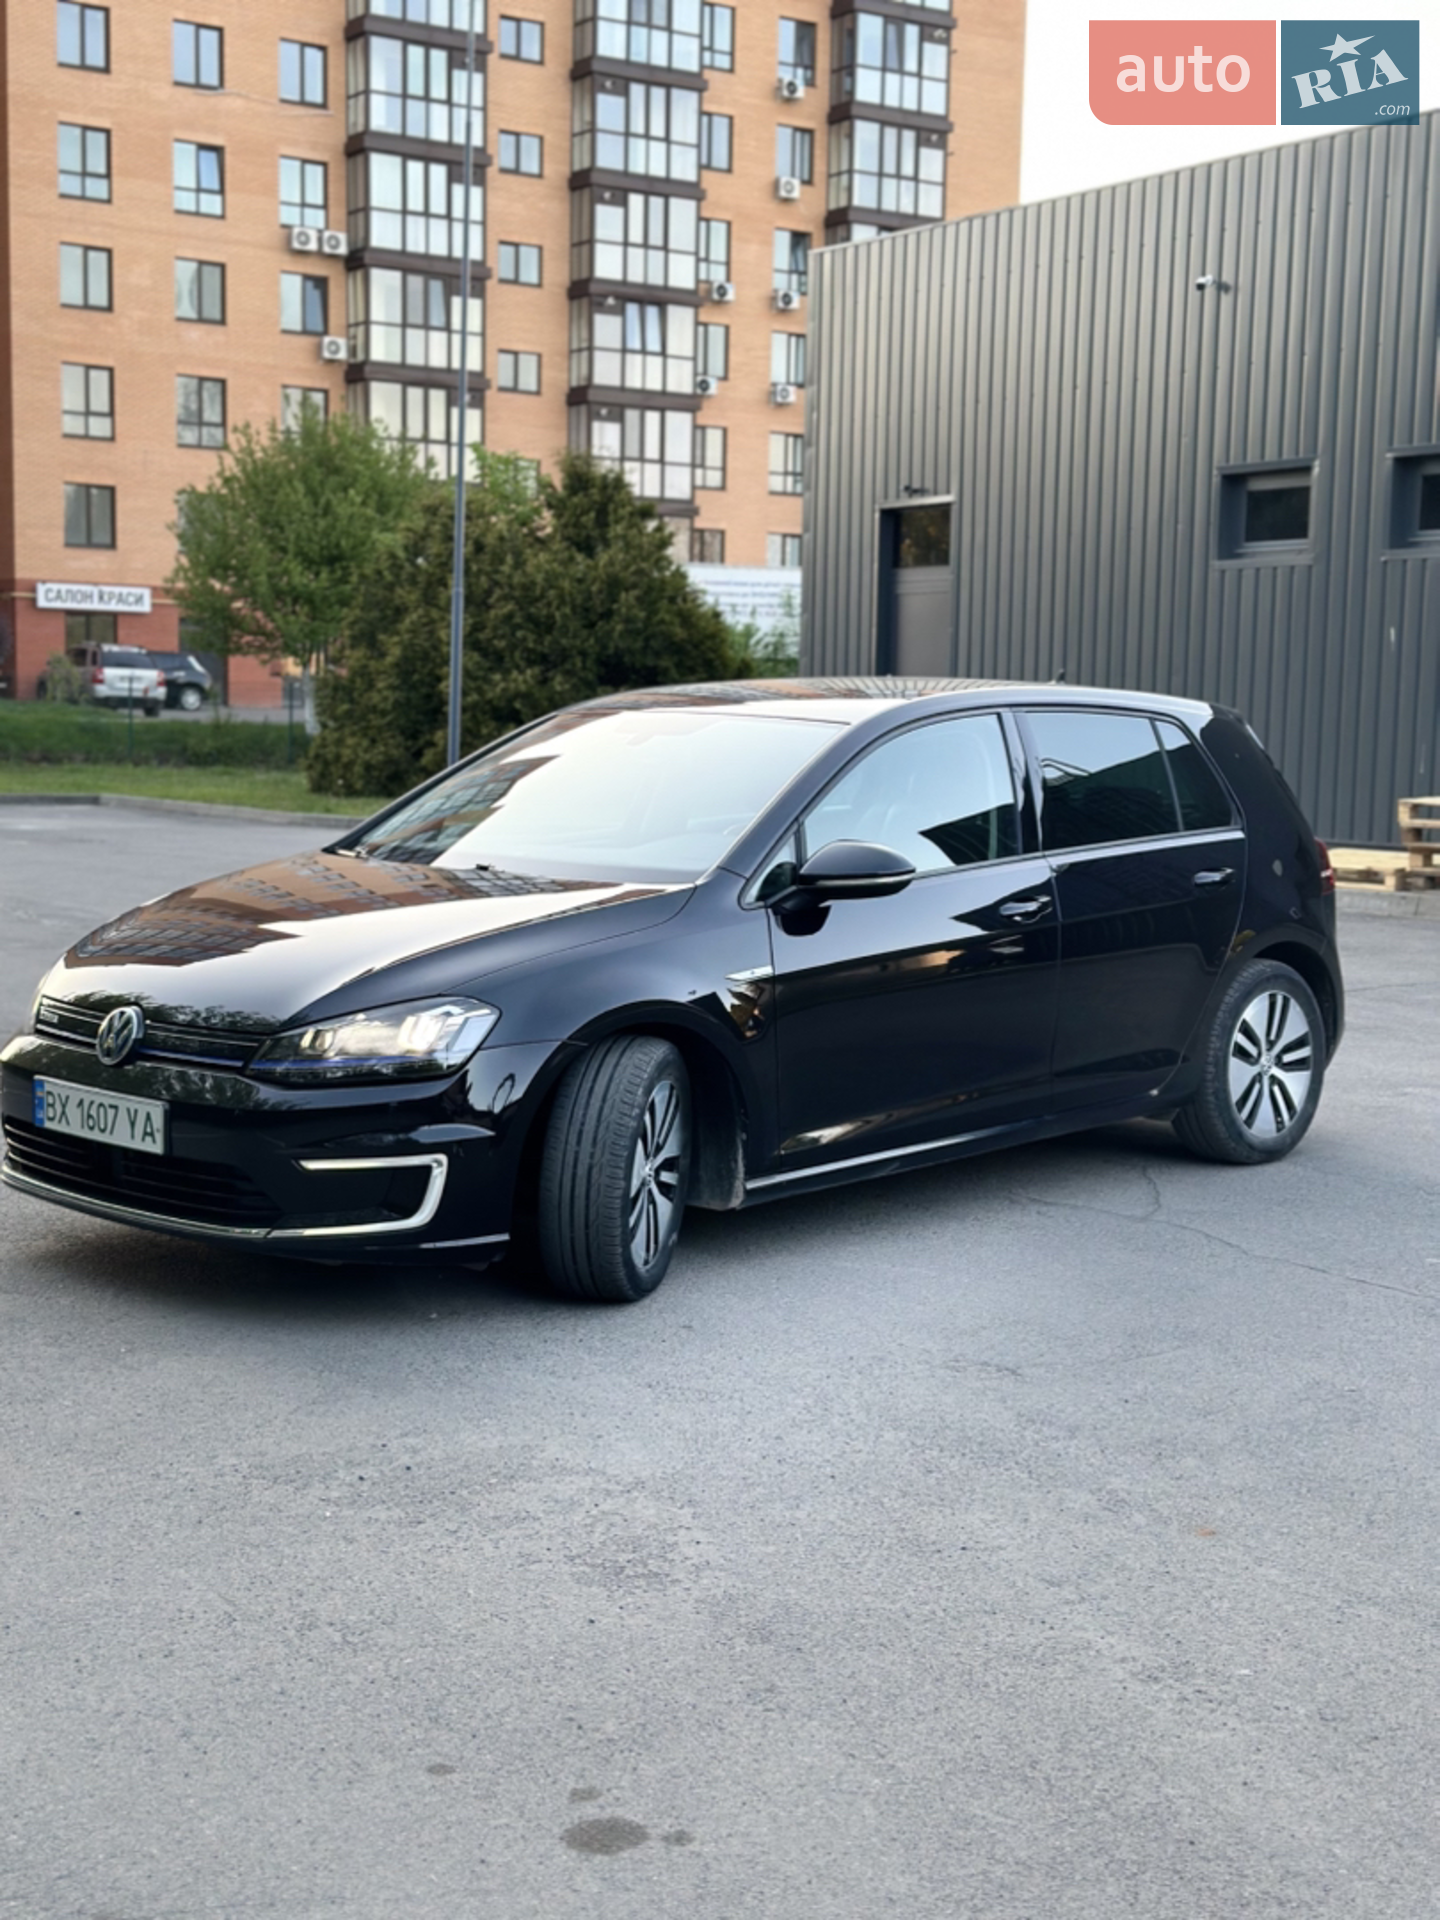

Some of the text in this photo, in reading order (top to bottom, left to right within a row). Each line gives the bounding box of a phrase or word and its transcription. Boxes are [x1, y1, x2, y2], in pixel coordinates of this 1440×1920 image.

[44, 588, 145, 608] САЛОН КРАСИ
[45, 1090, 157, 1144] BX 1607 YA
